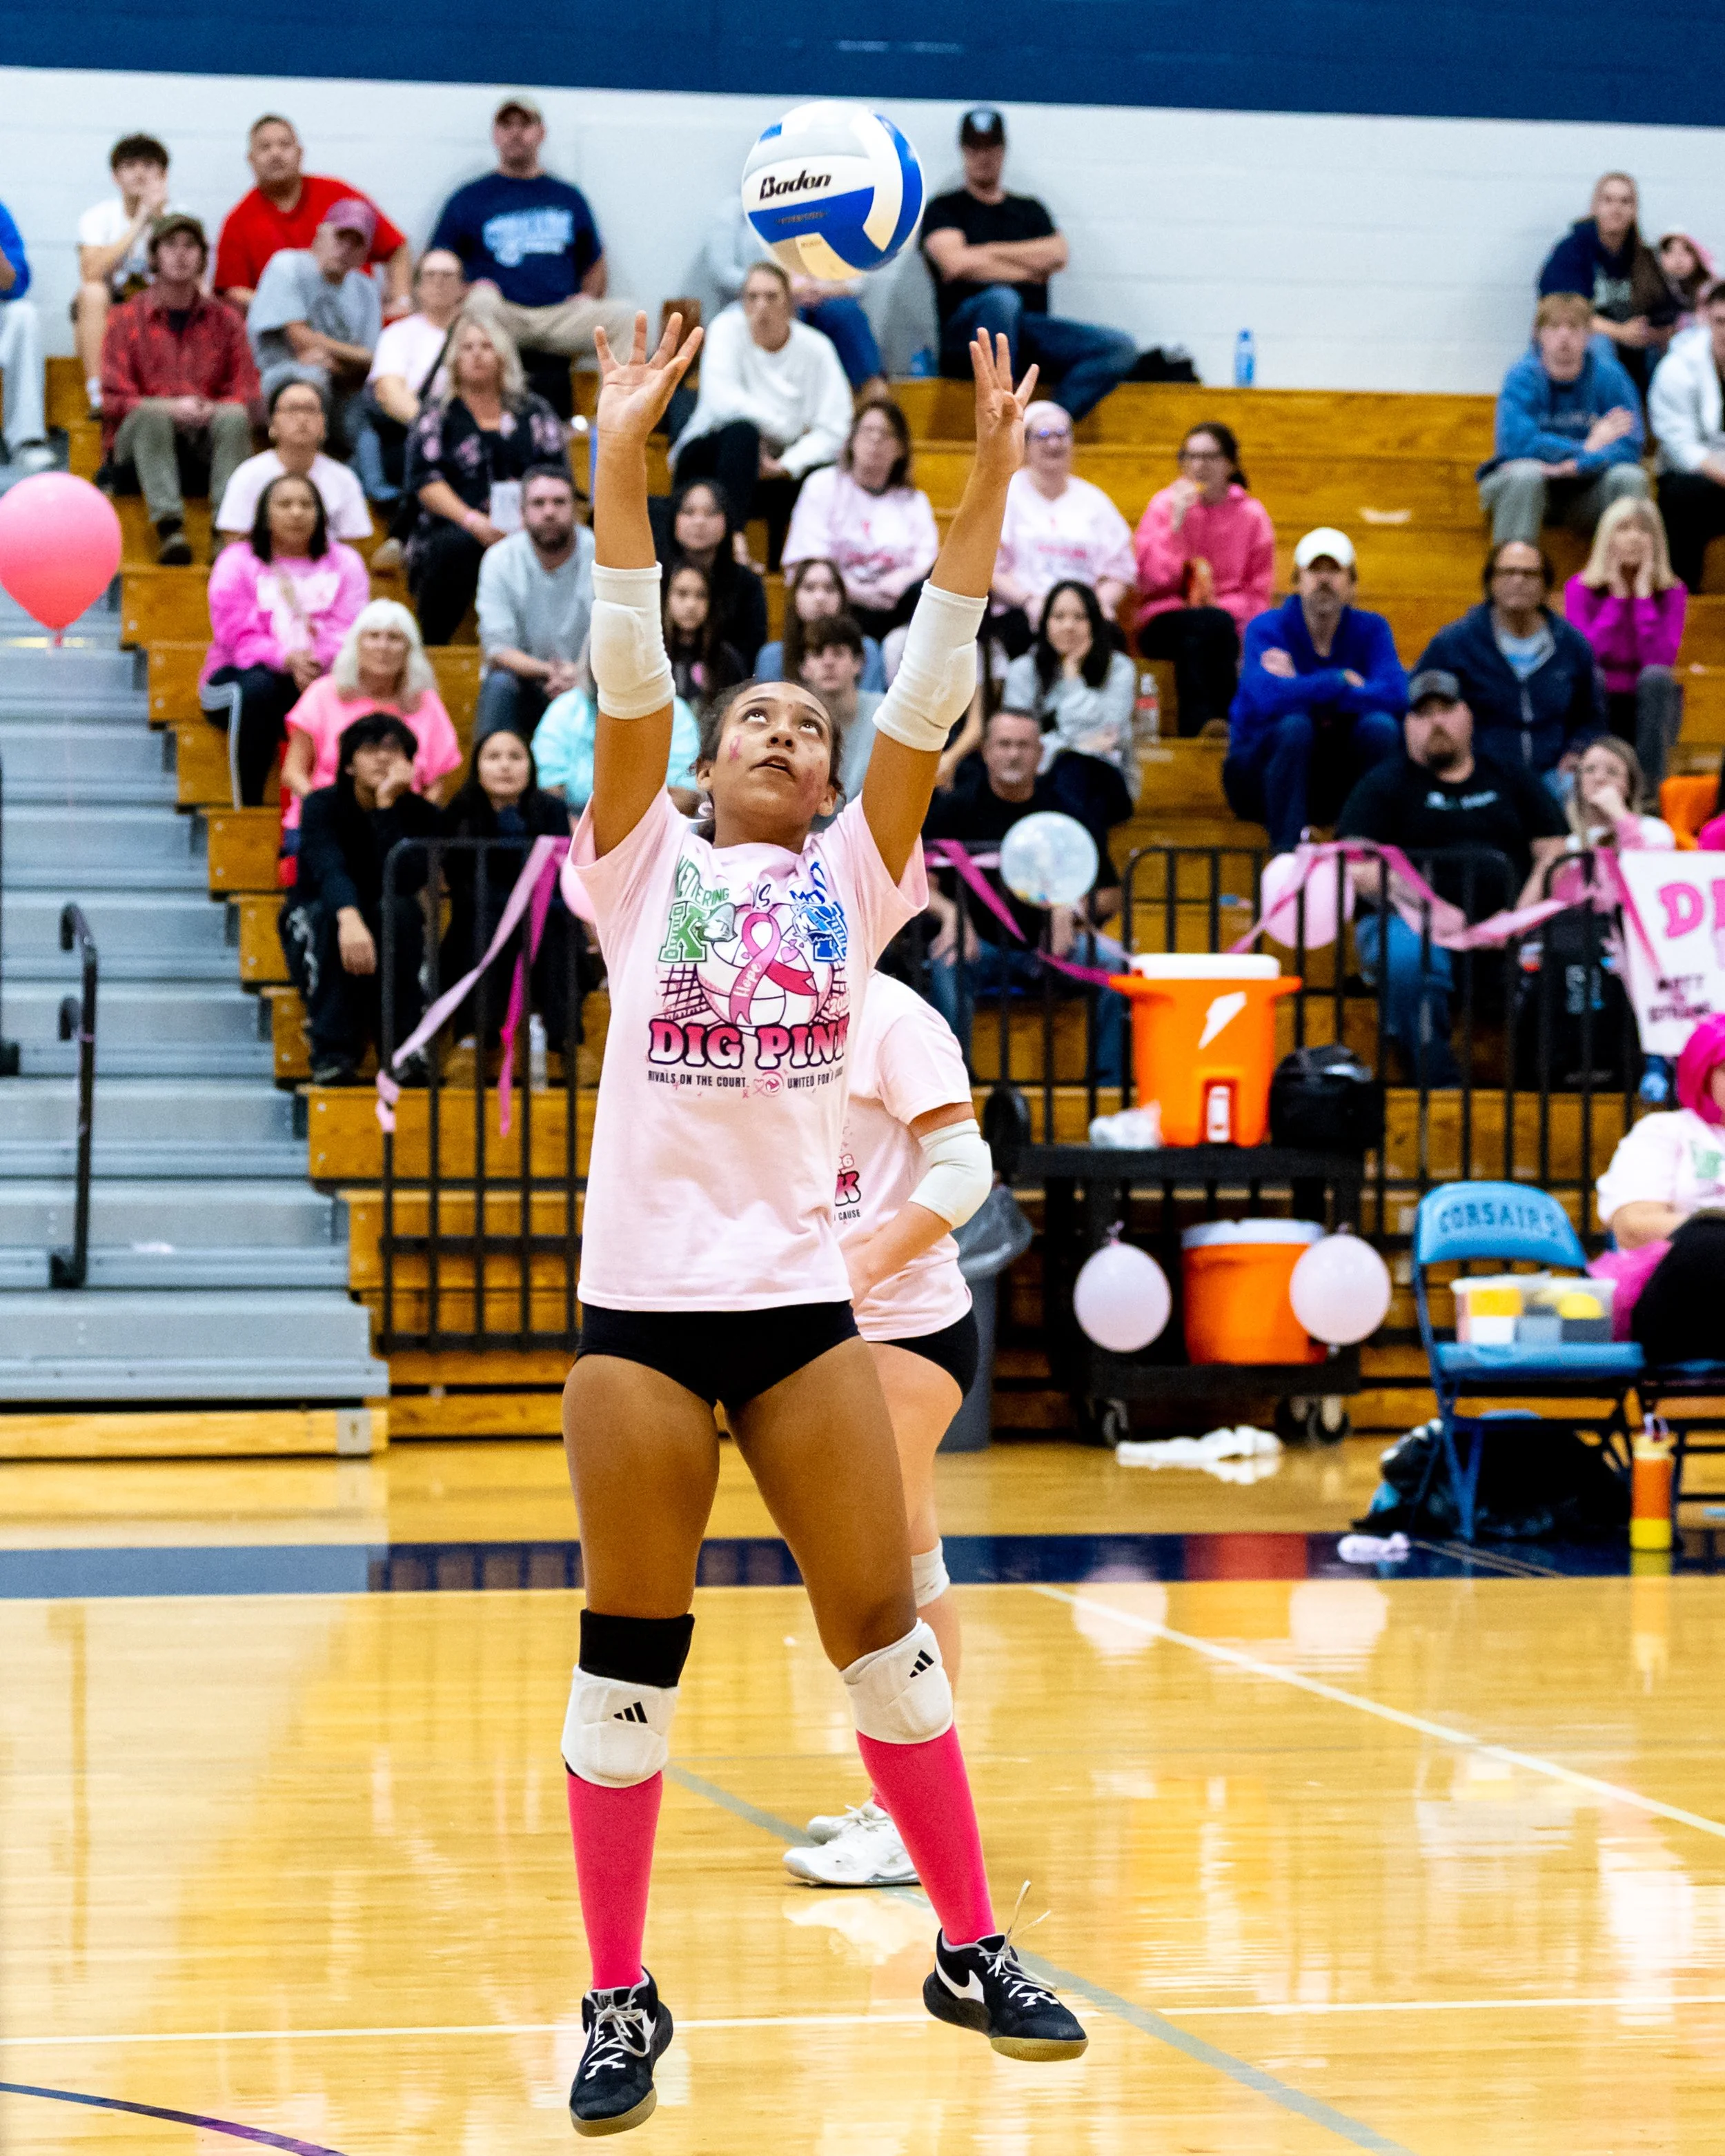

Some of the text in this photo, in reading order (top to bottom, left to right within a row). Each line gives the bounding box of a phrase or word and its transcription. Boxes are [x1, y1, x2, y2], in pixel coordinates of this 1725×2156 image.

[733, 962, 762, 998] Hope
[649, 1018, 744, 1069] DIG
[648, 1070, 676, 1084] RIVALS
[680, 1074, 692, 1085] ON
[696, 1075, 713, 1087] THE
[787, 1076, 814, 1089] UNITED
[838, 1209, 861, 1220] CAUSE
[1439, 1202, 1559, 1237] CORSAIRS
